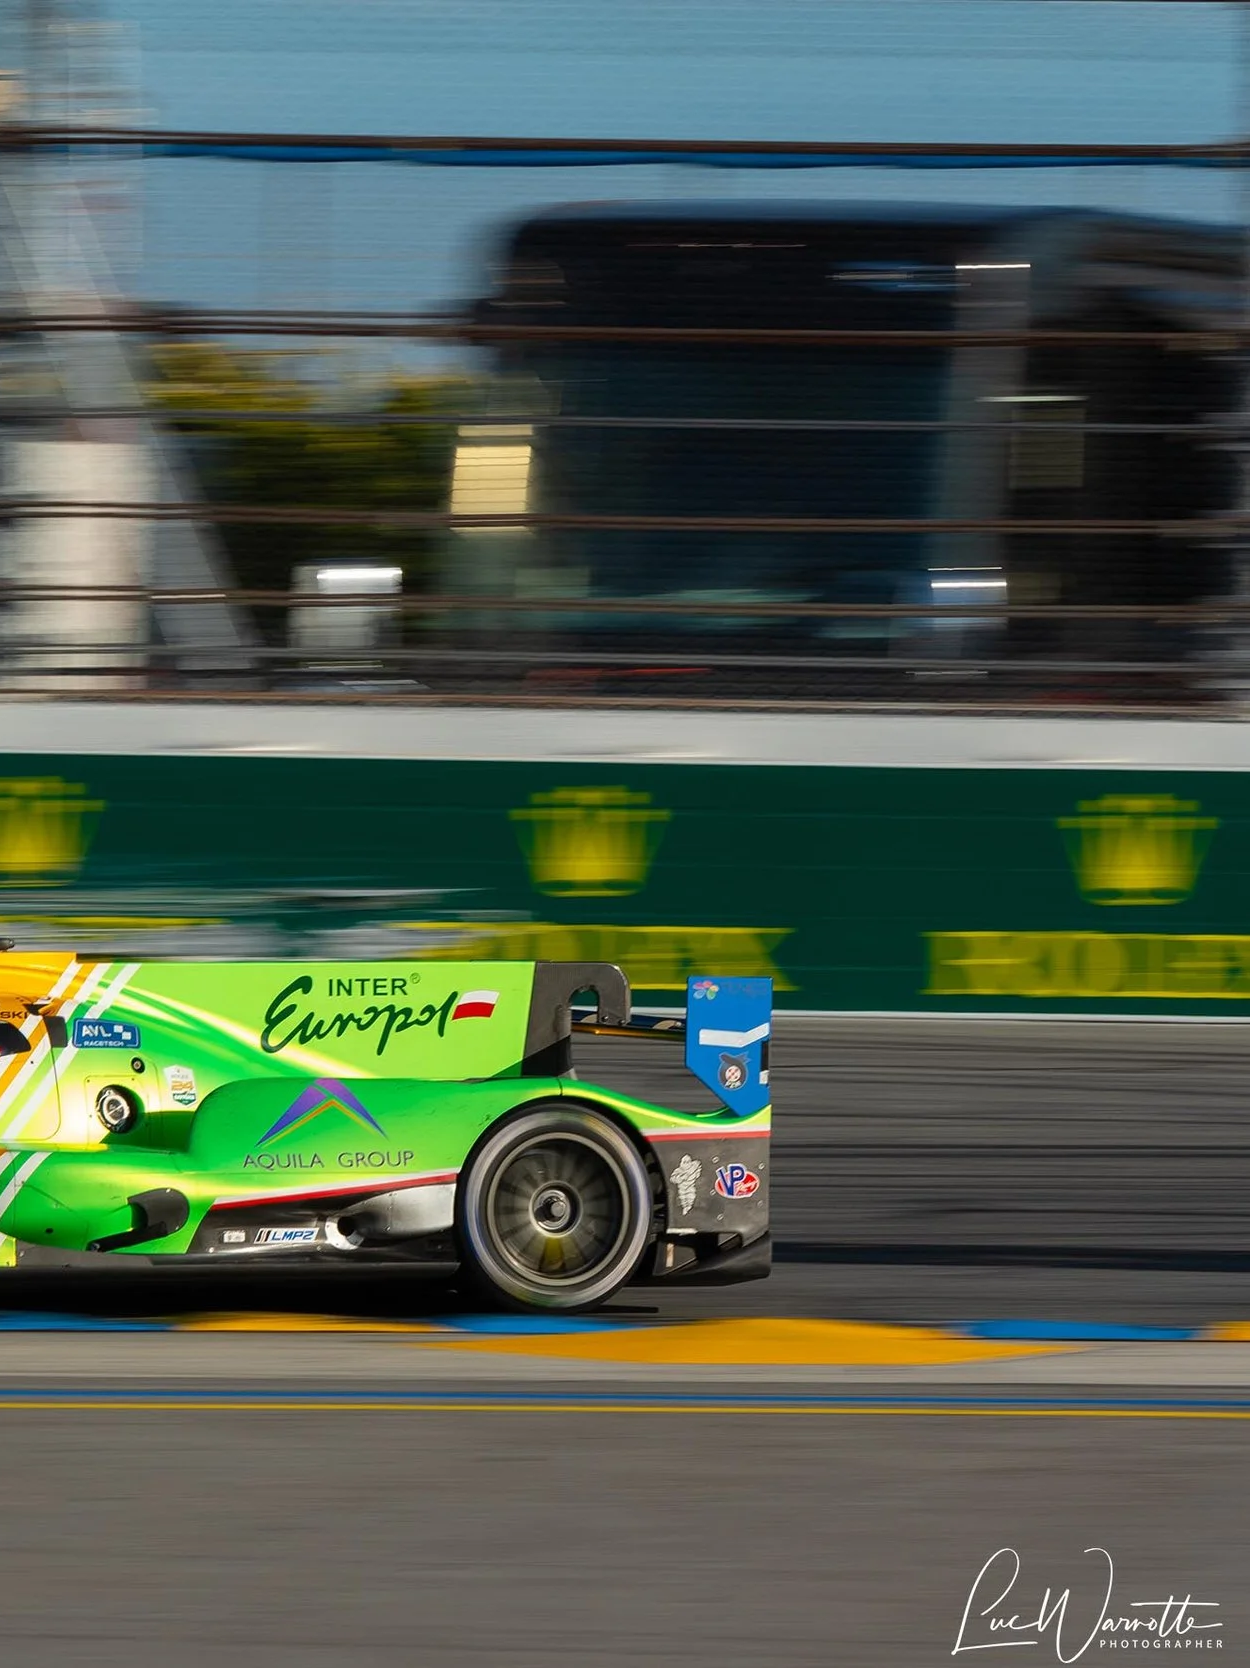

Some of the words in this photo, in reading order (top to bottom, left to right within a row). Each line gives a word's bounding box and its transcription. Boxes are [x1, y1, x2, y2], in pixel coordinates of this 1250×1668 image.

[328, 977, 408, 997] INTER
[260, 975, 459, 1056] Europol
[82, 1024, 112, 1038] AVL
[242, 1153, 325, 1171] AQUILA
[337, 1150, 415, 1169] GROUP
[716, 1164, 747, 1198] VP
[271, 1230, 315, 1241] LMP2
